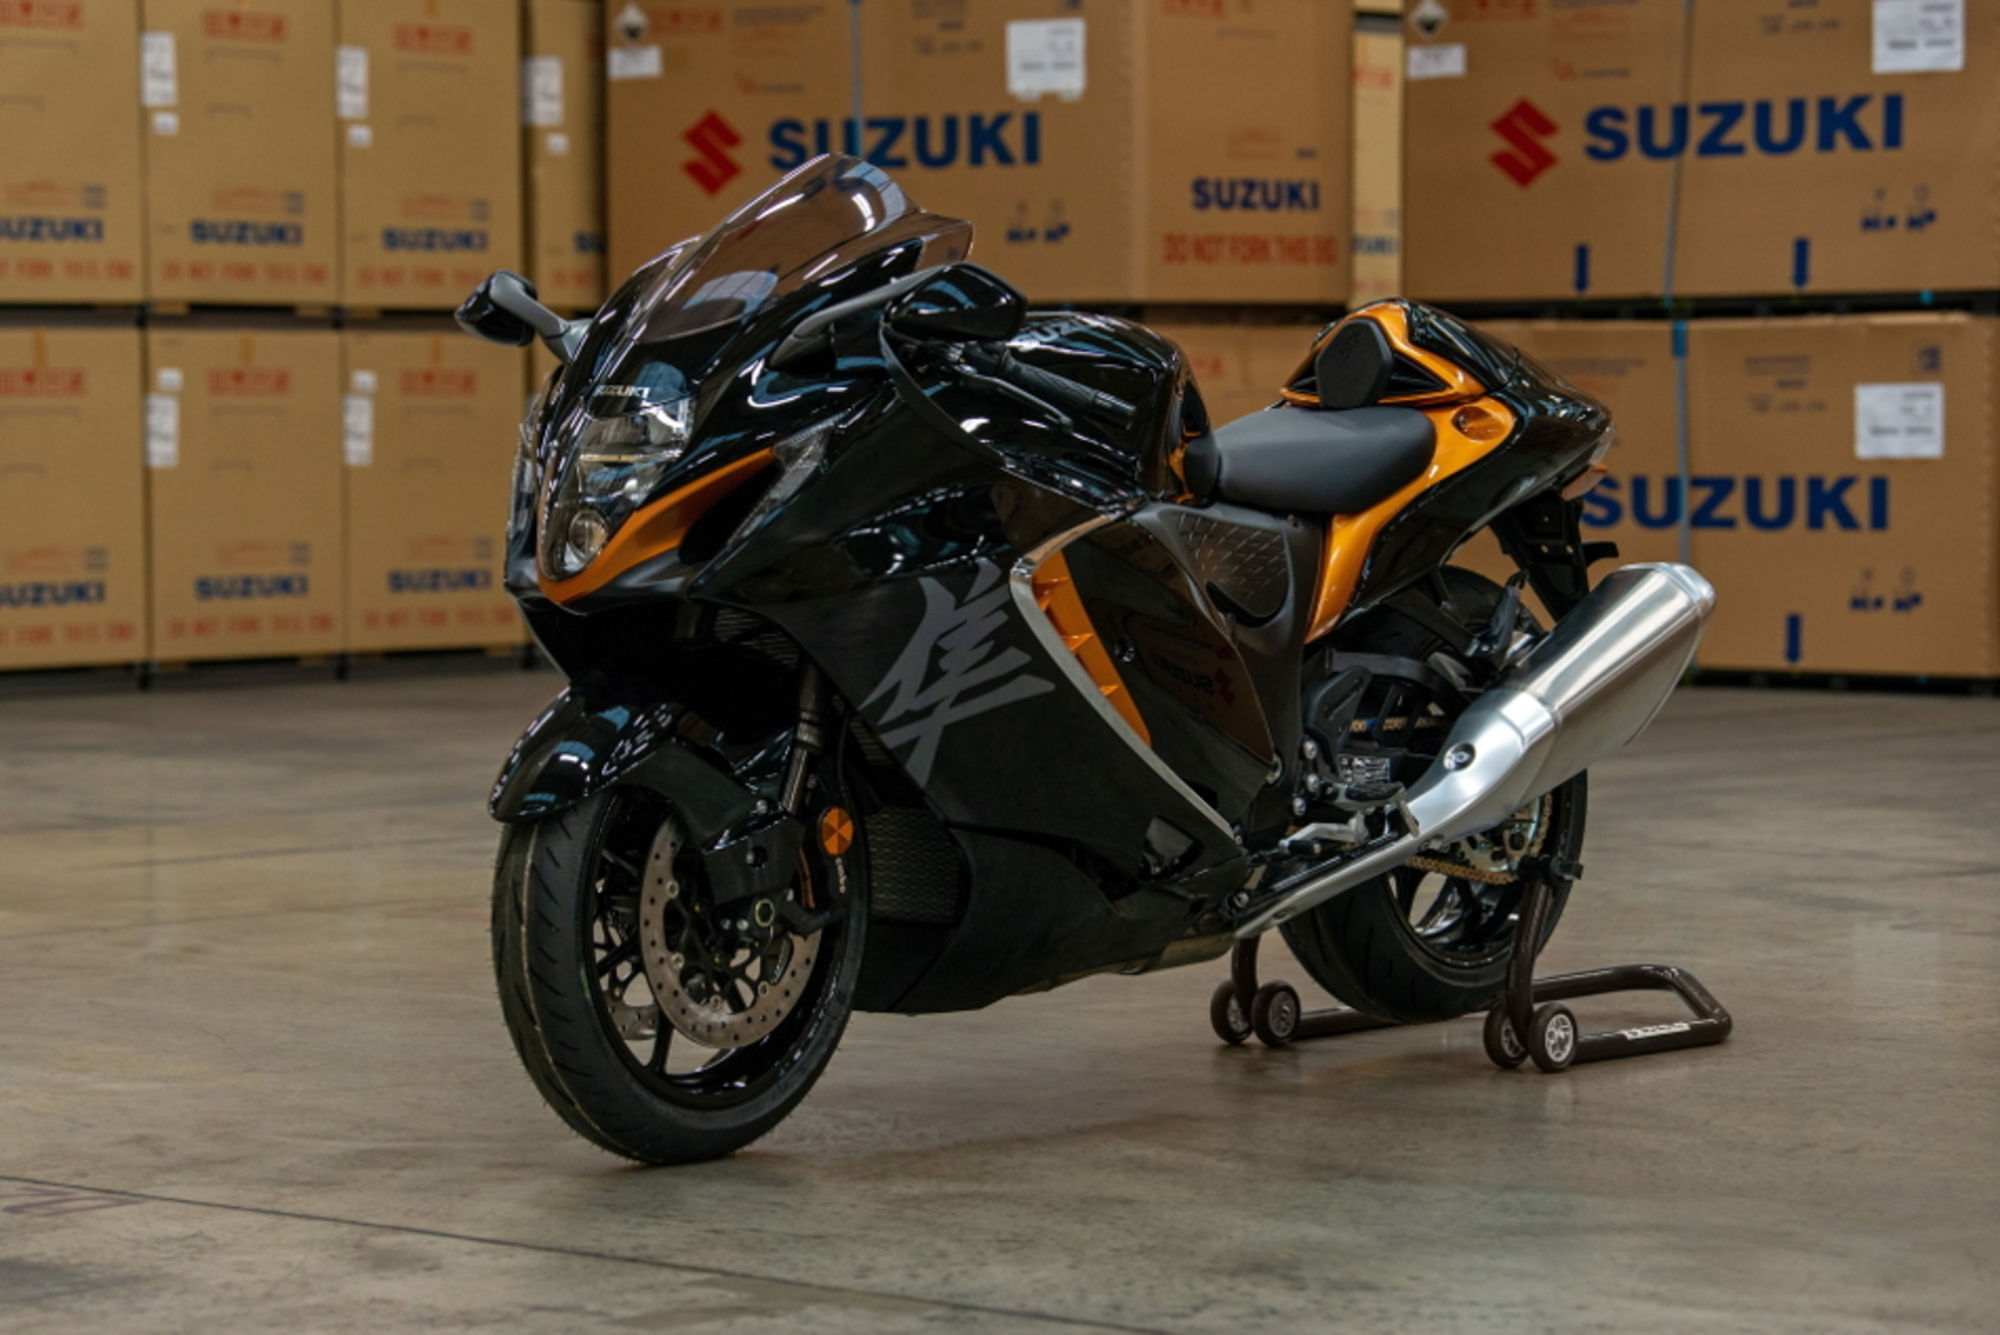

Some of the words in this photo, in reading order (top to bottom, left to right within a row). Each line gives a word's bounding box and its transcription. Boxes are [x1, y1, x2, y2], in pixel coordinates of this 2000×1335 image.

[768, 111, 1041, 171] SUZUKI
[1582, 93, 1904, 162] SUZUKI
[1191, 176, 1321, 212] SUZUKI
[1577, 475, 1890, 531] SUZUKI
